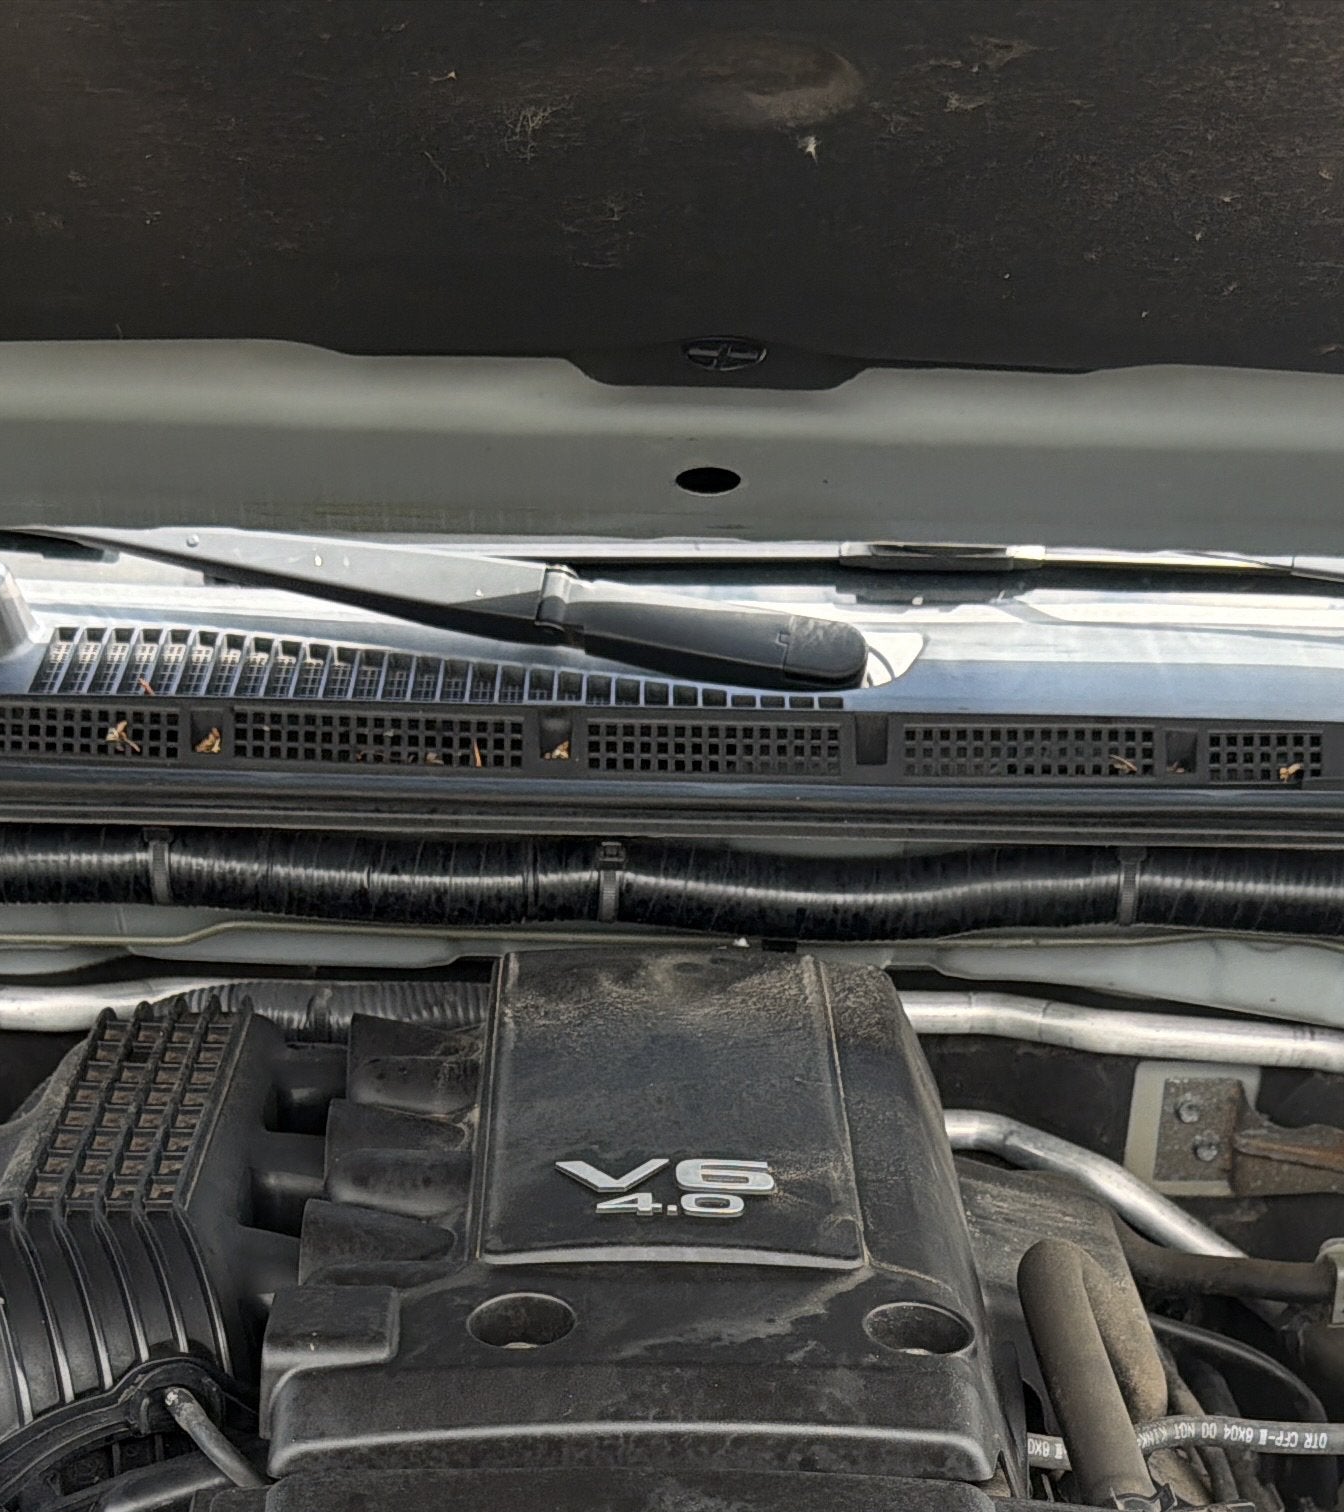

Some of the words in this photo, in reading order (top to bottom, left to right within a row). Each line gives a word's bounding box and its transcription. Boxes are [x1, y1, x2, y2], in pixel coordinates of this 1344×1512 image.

[556, 1158, 775, 1195] V6
[596, 1192, 745, 1219] 4.0
[1175, 1422, 1195, 1439] NOT
[1201, 1422, 1217, 1439] DO
[1028, 1439, 1049, 1456] 8X0
[1304, 1432, 1327, 1450] DTR
